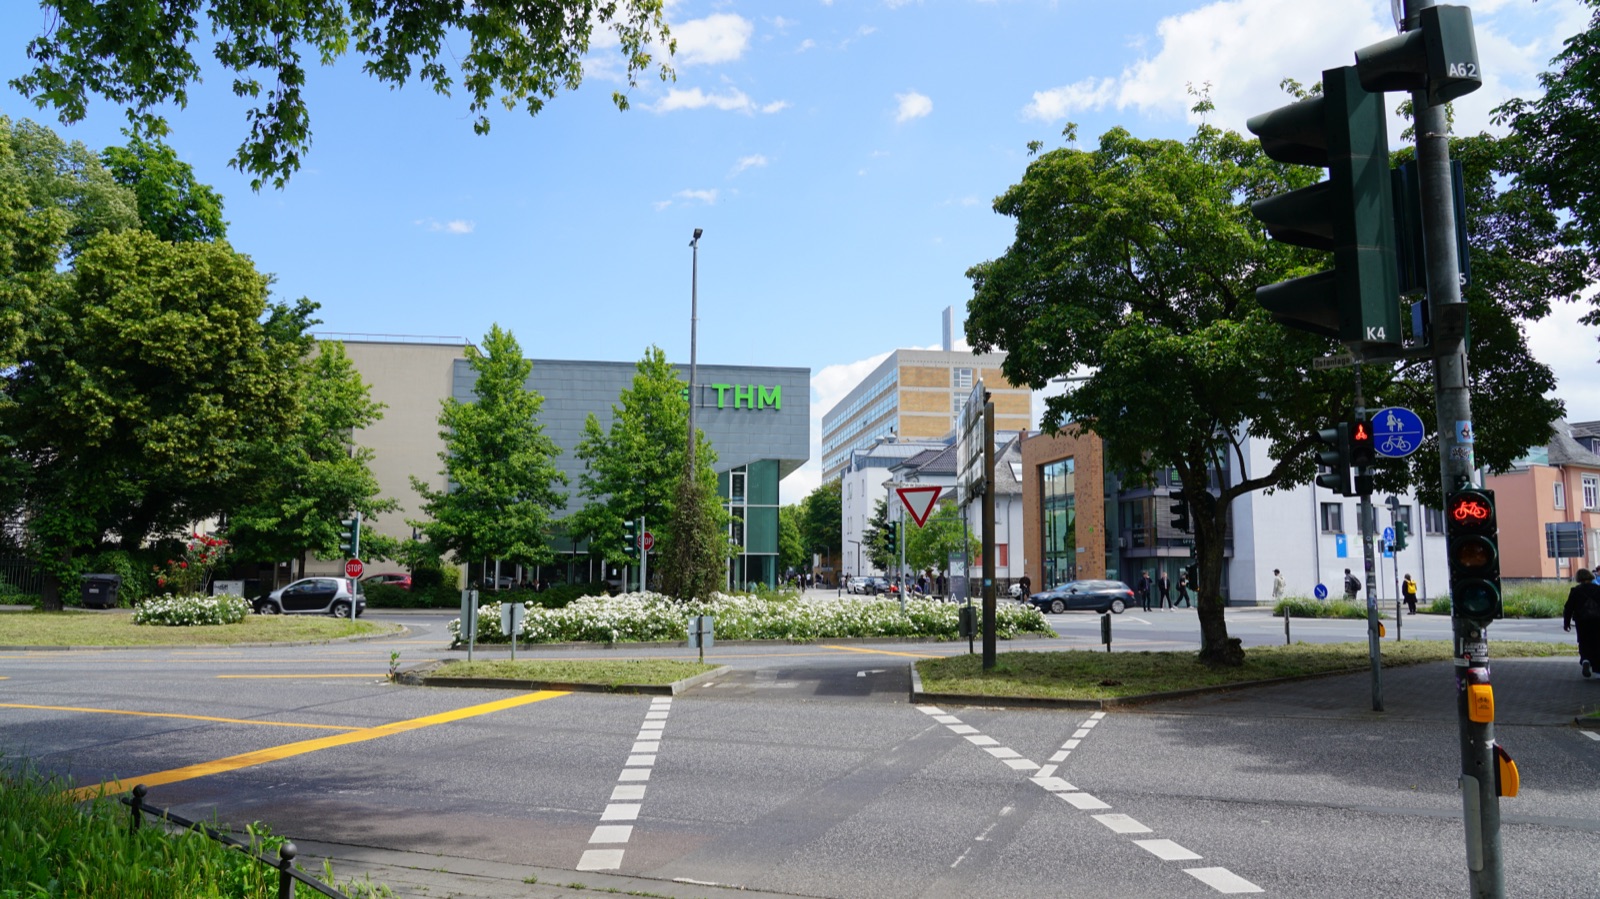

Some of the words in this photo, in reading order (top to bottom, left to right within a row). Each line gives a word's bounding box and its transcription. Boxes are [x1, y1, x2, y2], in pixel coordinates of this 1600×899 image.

[1448, 62, 1478, 77] A62
[1366, 326, 1386, 340] K4
[711, 383, 782, 410] THM
[638, 537, 652, 546] SOP
[346, 563, 362, 573] STOP
